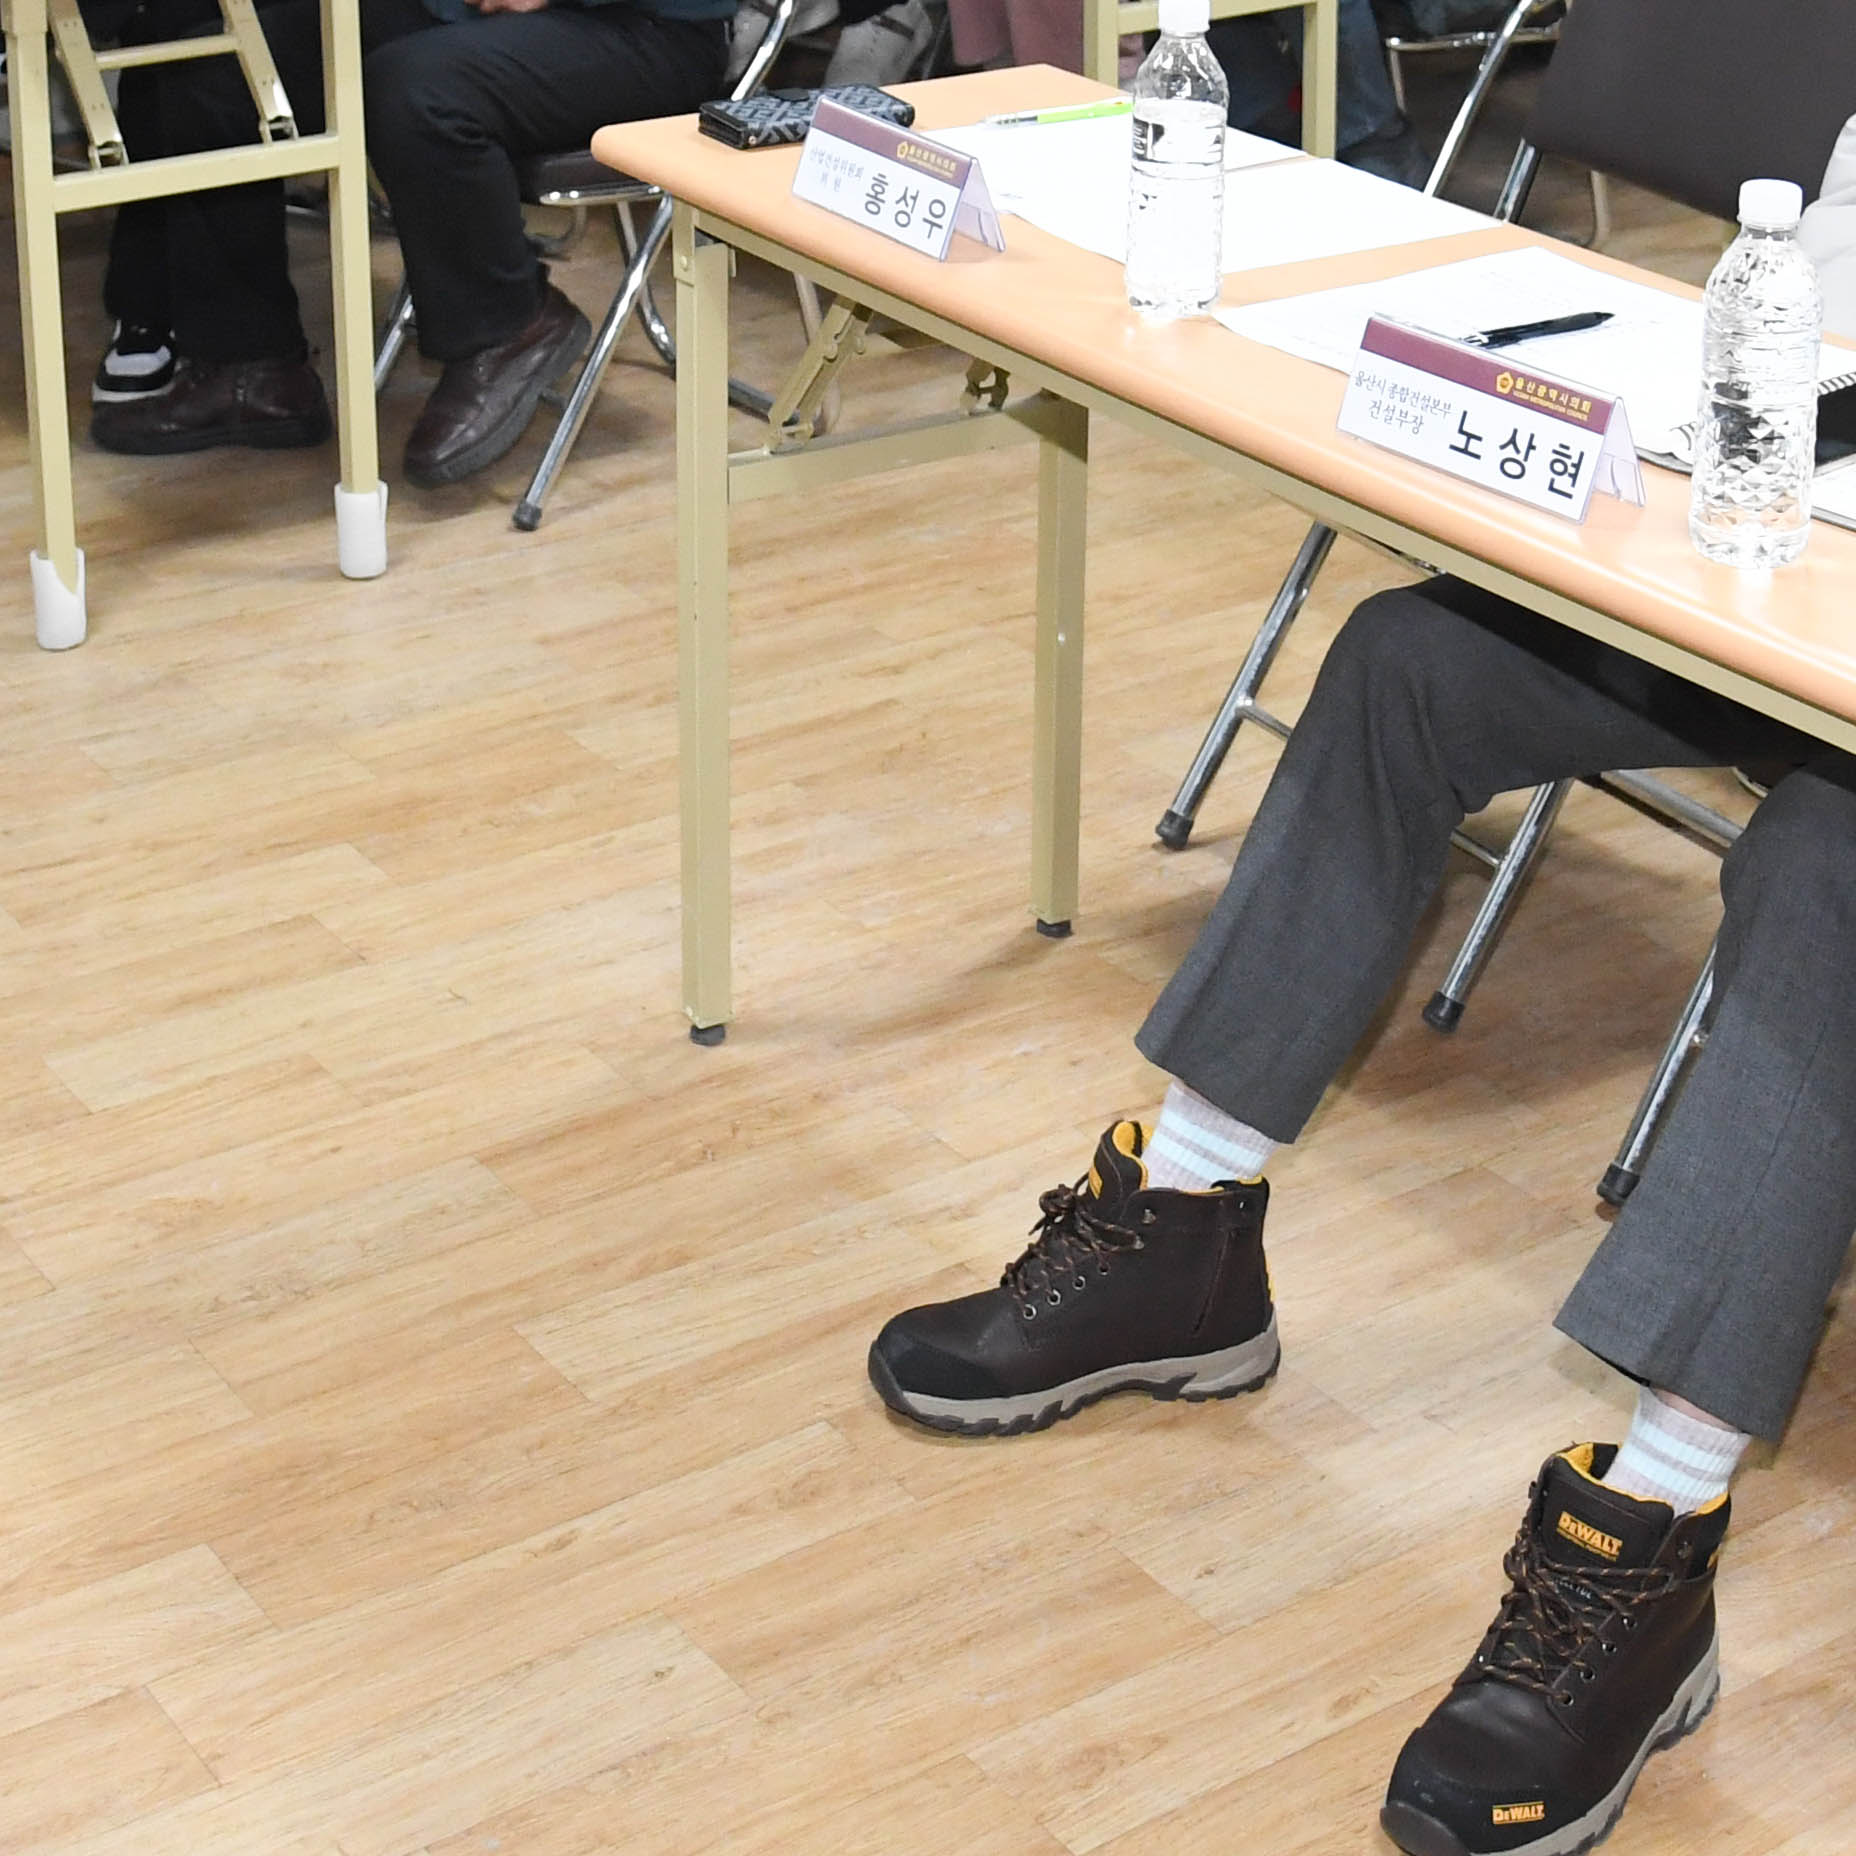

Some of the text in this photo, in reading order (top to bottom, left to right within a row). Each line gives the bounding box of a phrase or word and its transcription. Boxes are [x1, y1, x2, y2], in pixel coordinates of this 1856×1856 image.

[1354, 370, 1387, 395] 울산시
[1515, 375, 1592, 413] 울산광역시의회
[1368, 399, 1425, 435] 건설부장
